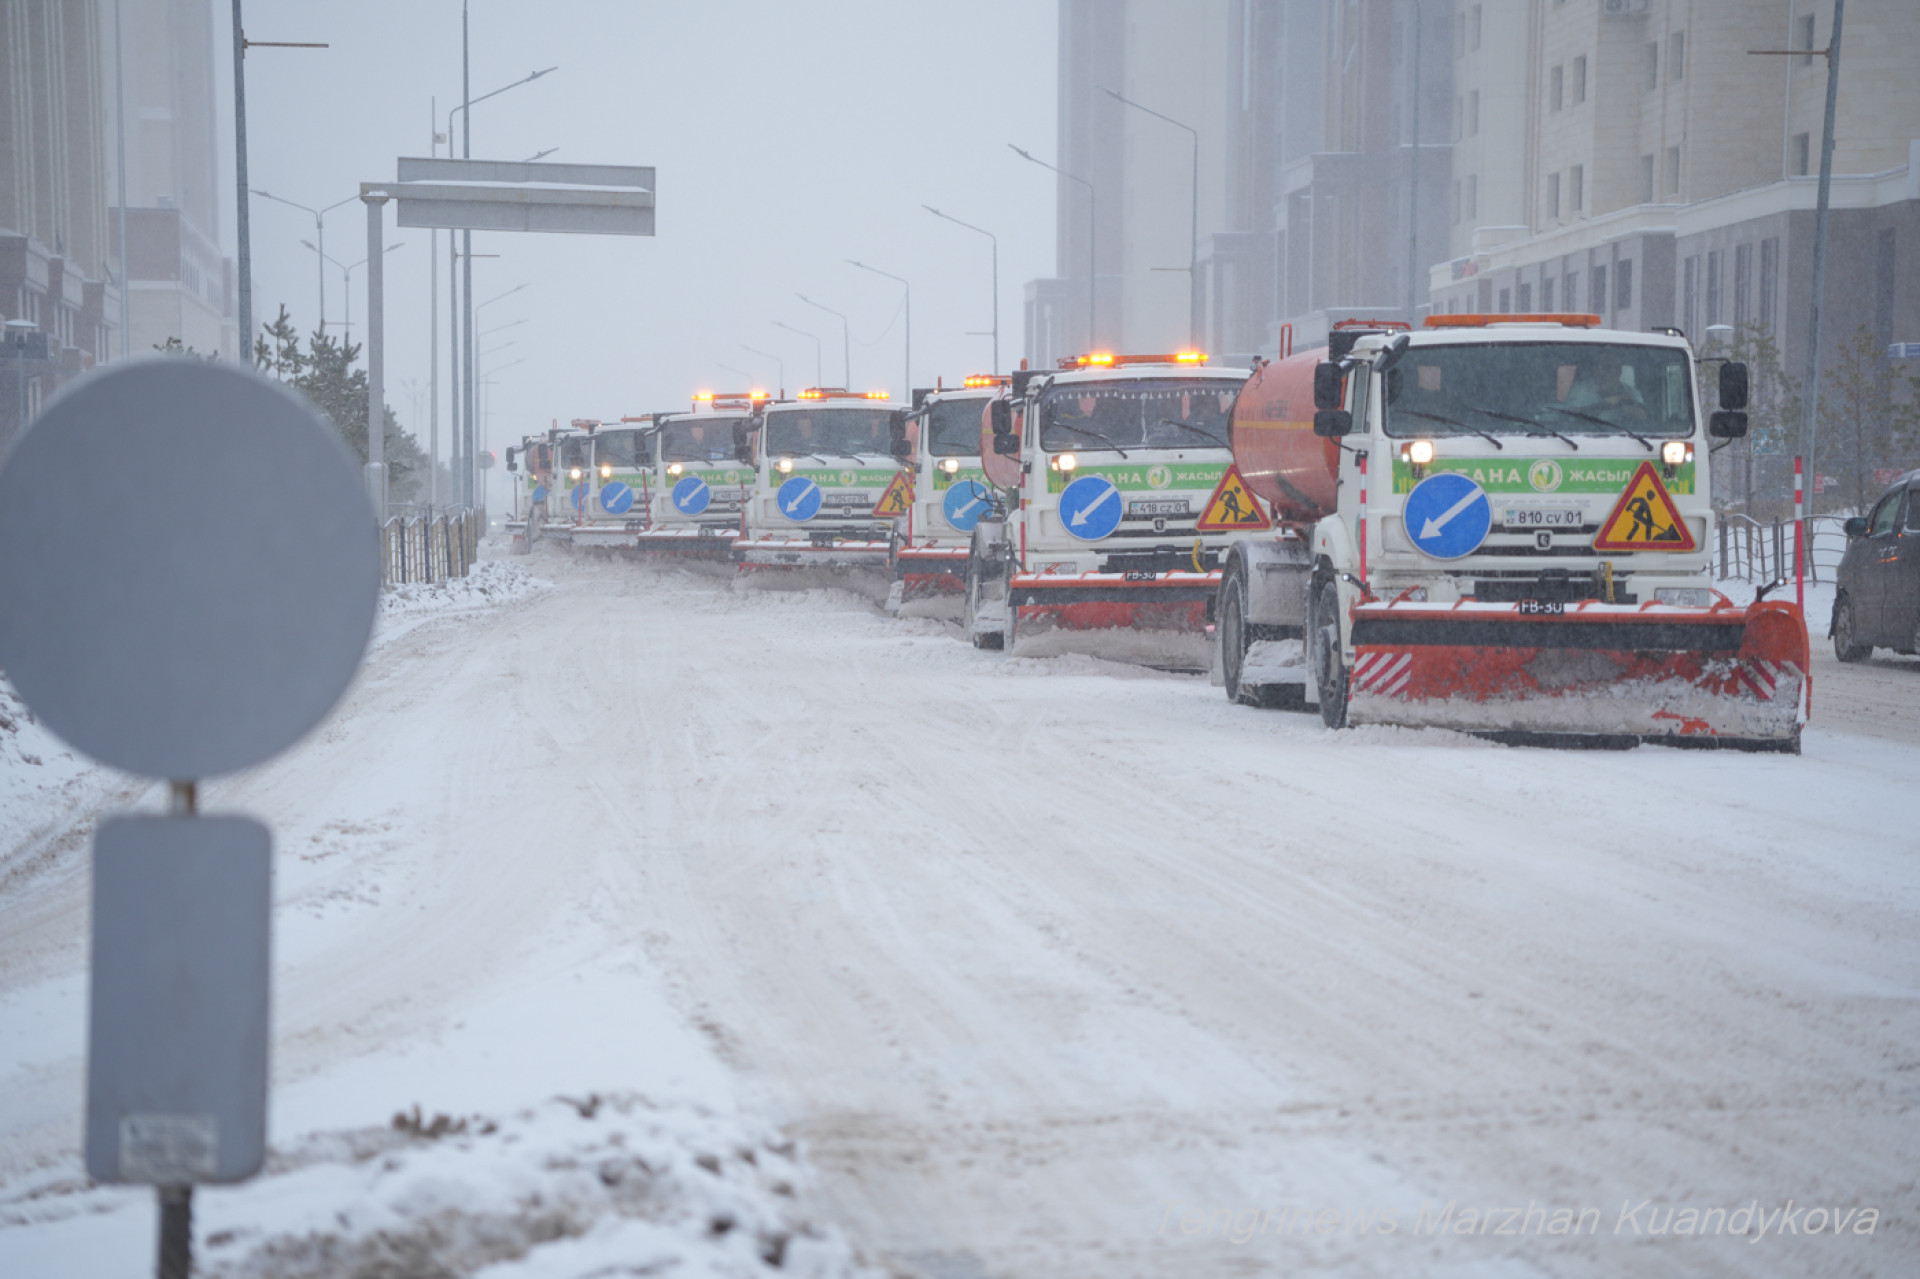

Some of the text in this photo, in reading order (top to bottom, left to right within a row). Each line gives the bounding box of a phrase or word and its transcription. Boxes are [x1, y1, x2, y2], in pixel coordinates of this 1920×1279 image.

[1176, 471, 1222, 481] ЖАСЫЛ
[1423, 468, 1631, 484] ТАНА ЖАСЫЛ
[1175, 503, 1188, 512] 01
[1519, 511, 1583, 524] 810 CV 01
